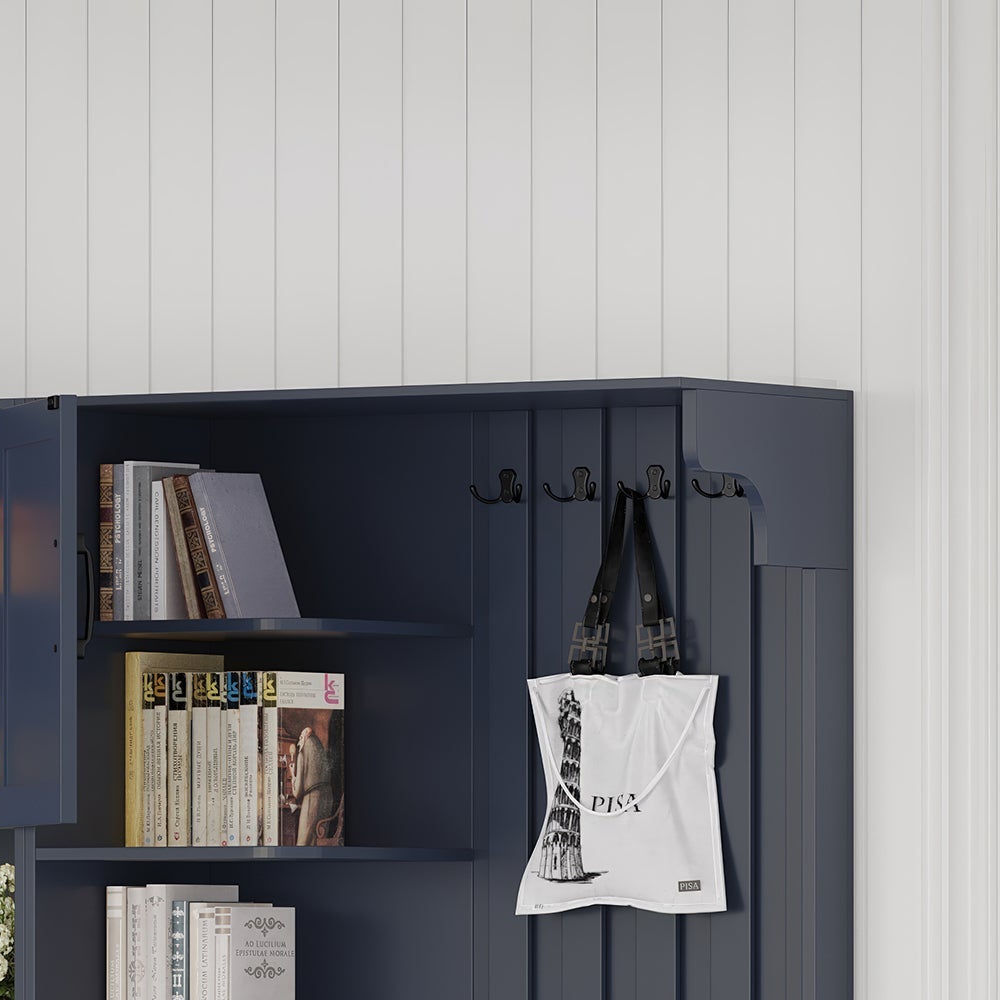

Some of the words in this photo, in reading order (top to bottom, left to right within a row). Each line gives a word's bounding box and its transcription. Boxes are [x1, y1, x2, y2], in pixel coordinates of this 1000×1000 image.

[591, 792, 642, 813] PISA
[679, 881, 700, 891] PISA
[200, 919, 208, 968] LATINARUM
